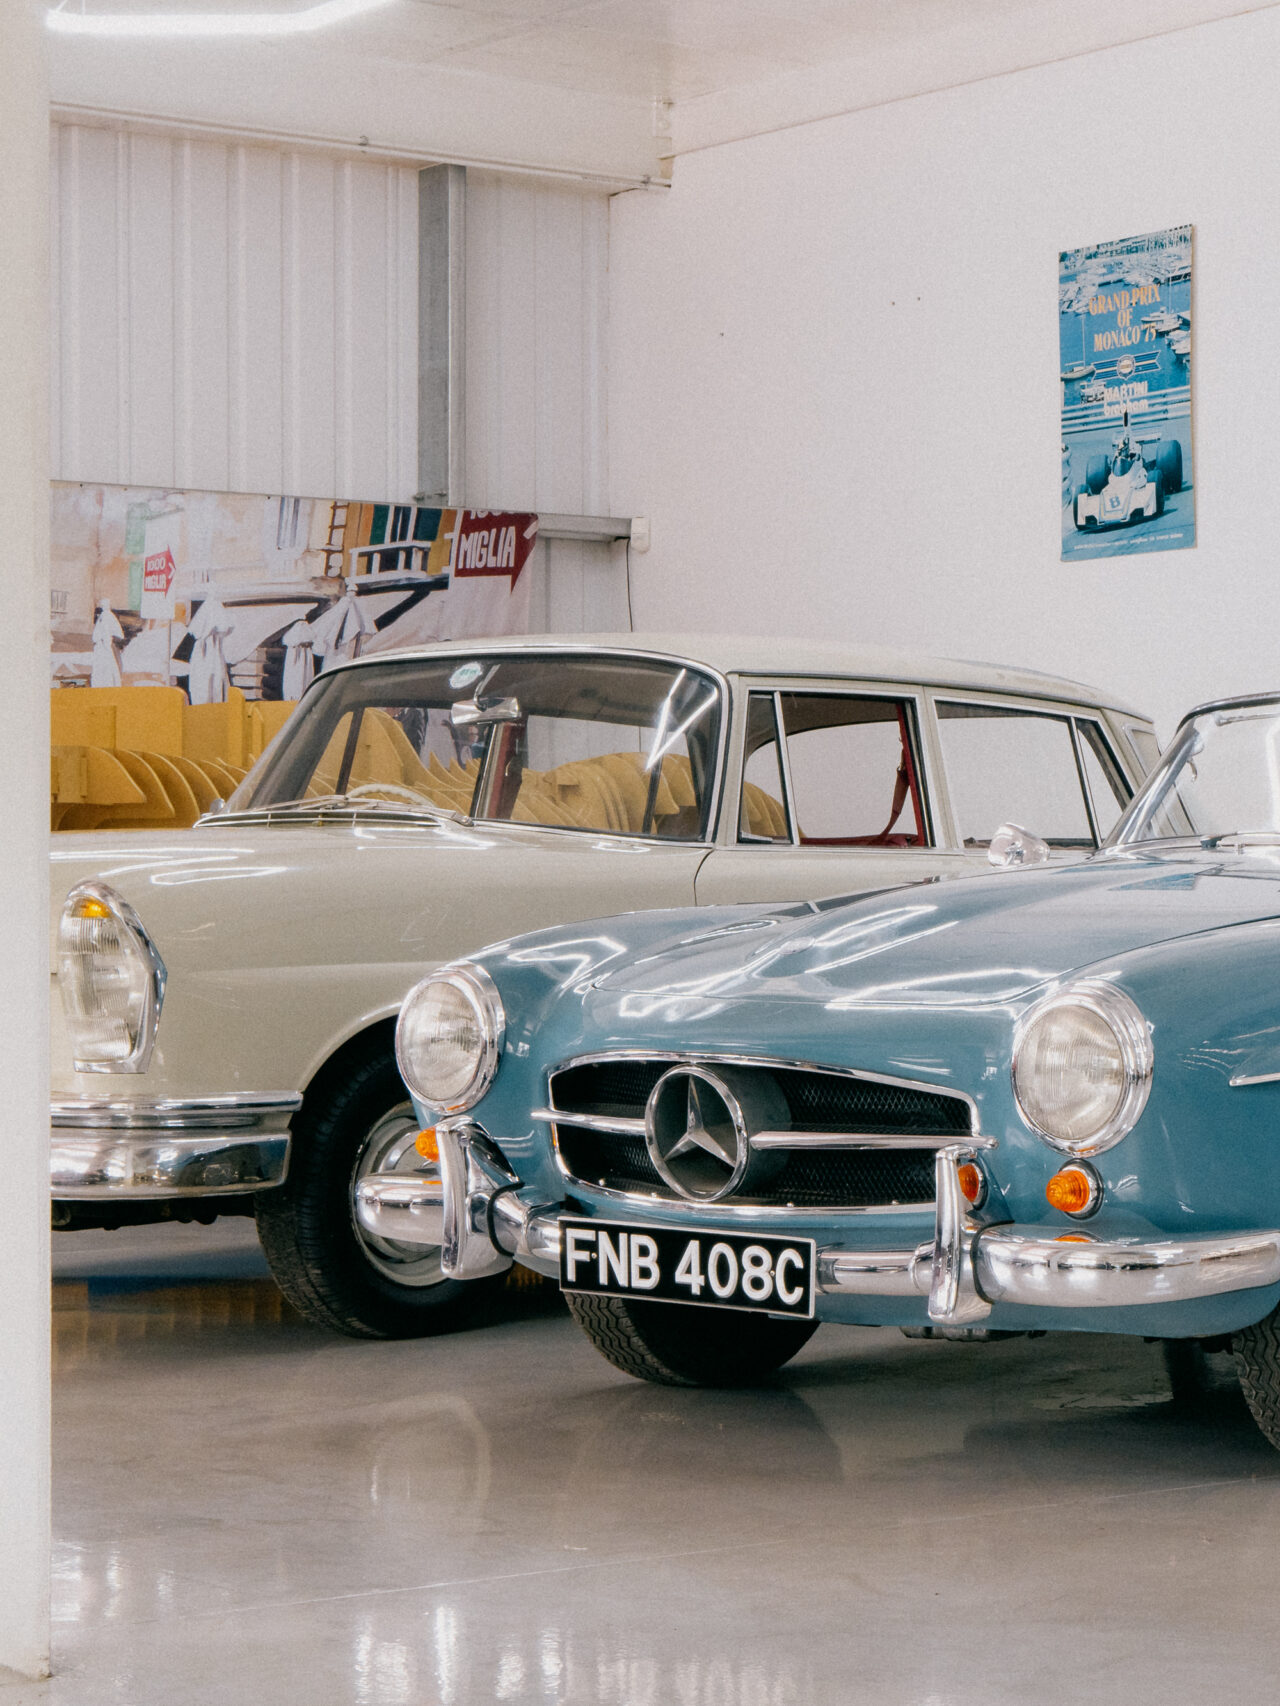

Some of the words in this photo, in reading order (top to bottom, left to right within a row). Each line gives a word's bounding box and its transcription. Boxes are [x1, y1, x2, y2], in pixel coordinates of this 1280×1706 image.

[1089, 290, 1130, 316] GRAND
[1131, 284, 1160, 306] PRIX
[1117, 309, 1133, 329] OF
[1094, 326, 1140, 352] MONACO
[1104, 381, 1148, 401] MARTINI
[458, 526, 516, 569] MIGLIA
[566, 1228, 660, 1290] FNB
[674, 1239, 804, 1305] 408C
